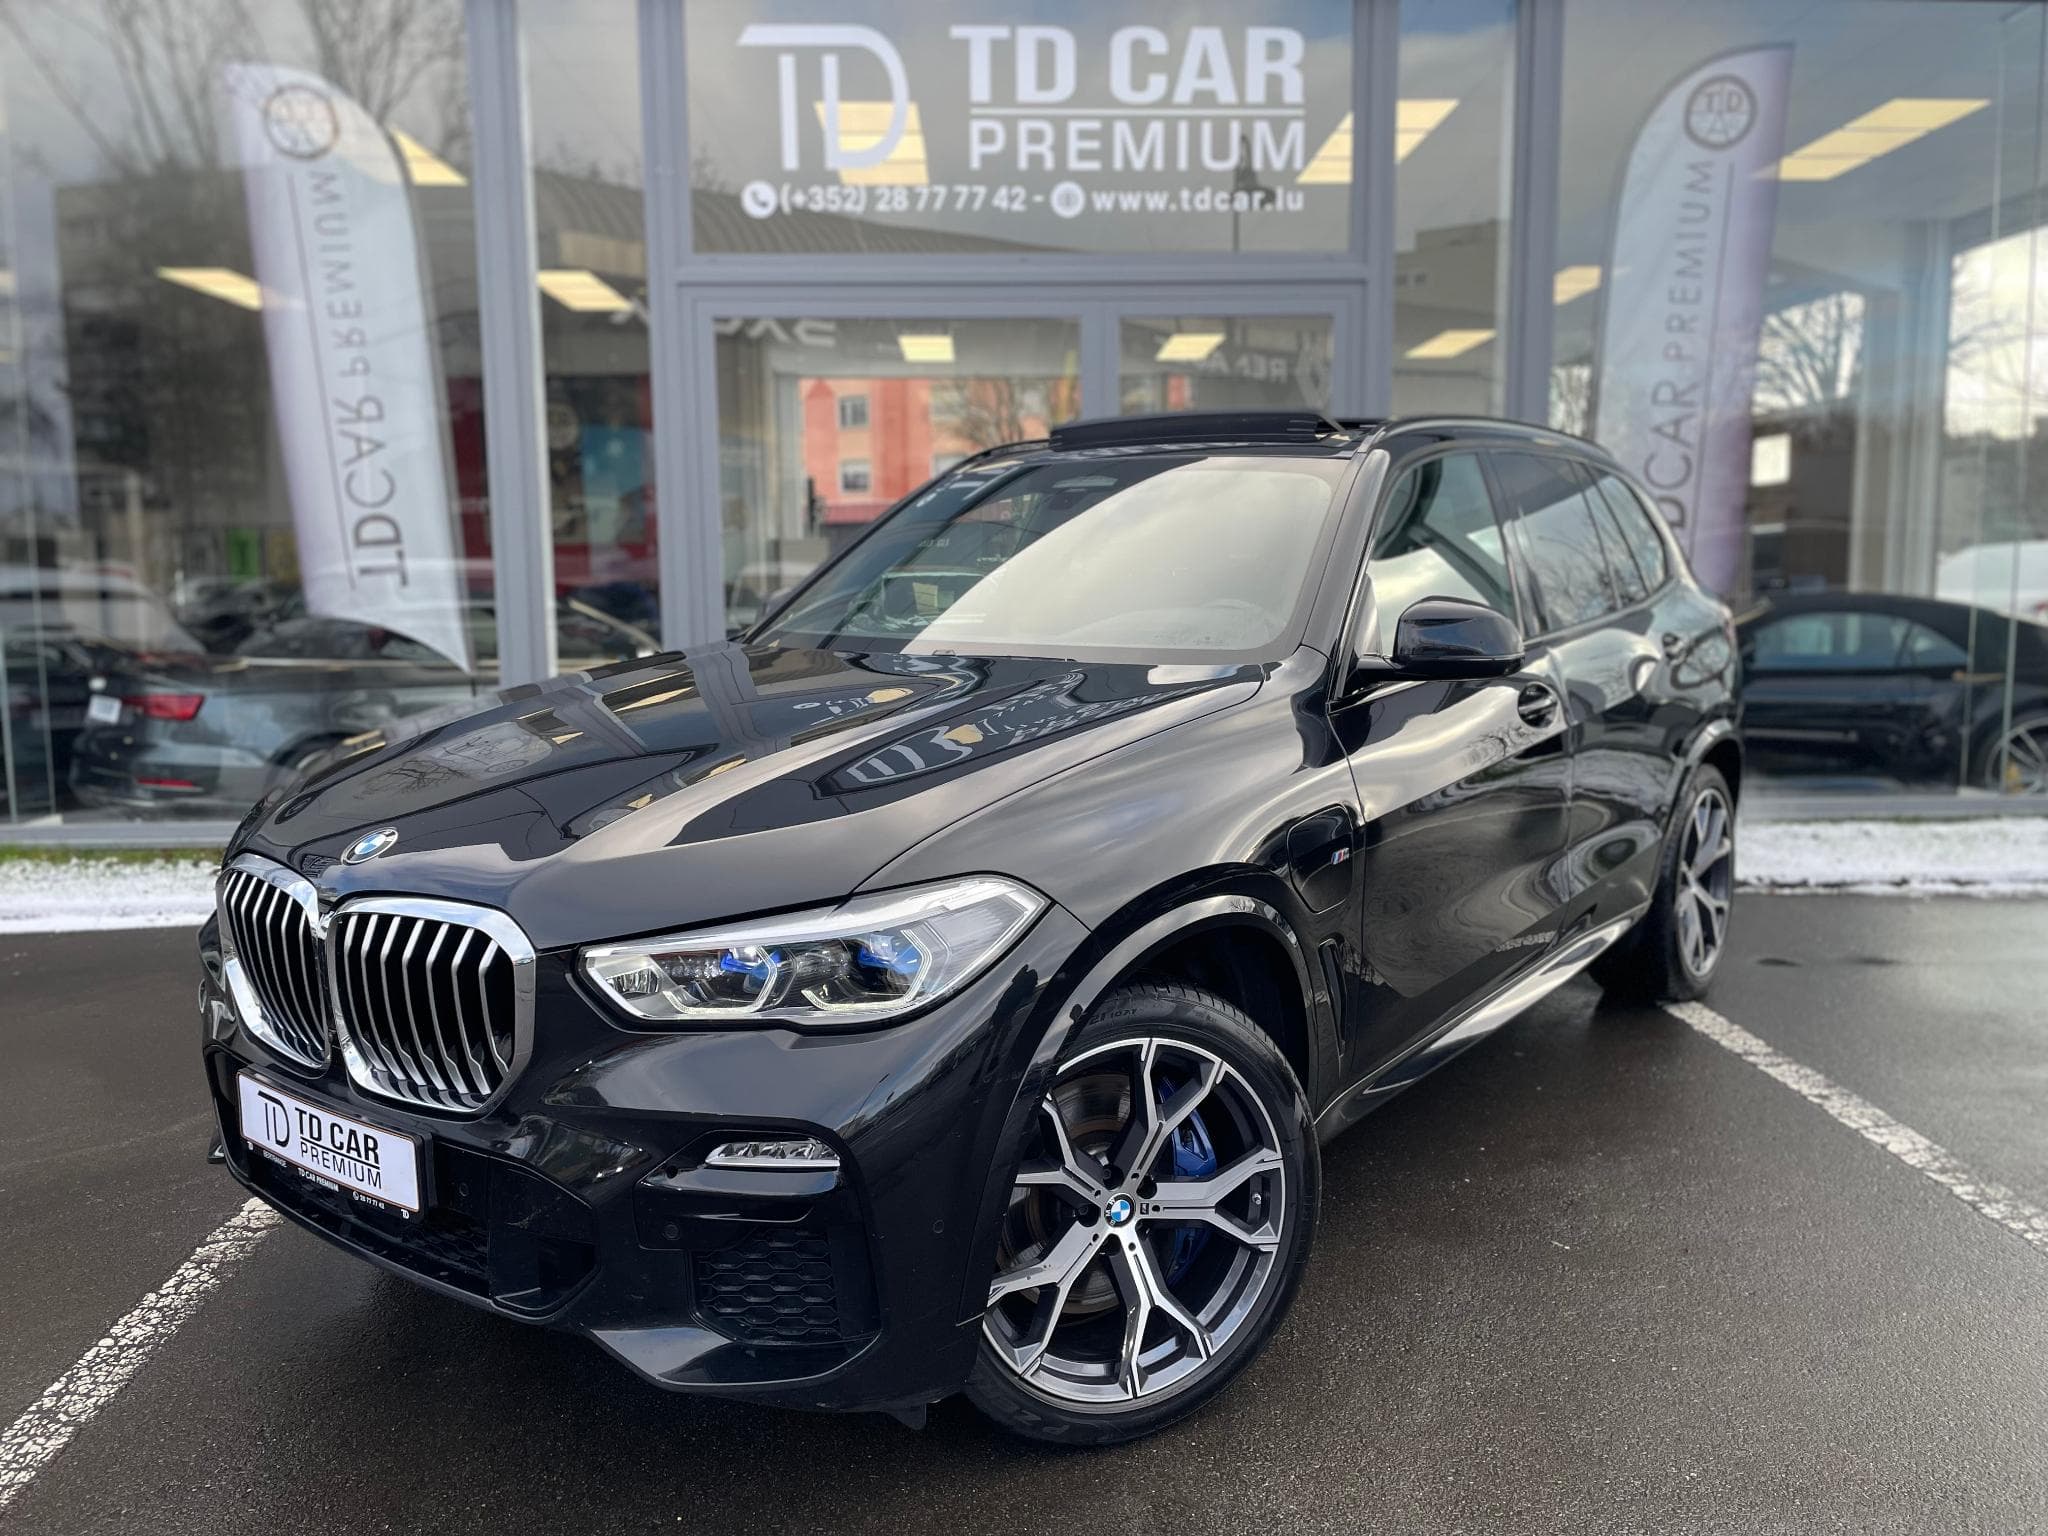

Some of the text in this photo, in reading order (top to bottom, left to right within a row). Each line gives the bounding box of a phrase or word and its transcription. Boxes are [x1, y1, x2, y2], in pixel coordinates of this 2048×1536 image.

[950, 25, 1305, 105] TD CAR
[736, 24, 908, 172] TD
[969, 118, 1305, 172] PREMIUM
[780, 183, 867, 214] (+352)
[874, 186, 909, 213] 28
[914, 186, 948, 213] 77
[952, 186, 987, 213] 77
[991, 186, 1027, 213] 42
[1091, 186, 1305, 213] www.tdcar.lu
[1643, 160, 1715, 528] DCAR PREMIUM
[257, 1090, 290, 1148] TD
[295, 1107, 322, 1142] TD
[330, 1122, 380, 1165] CAR
[300, 1141, 382, 1190] PREMIUM
